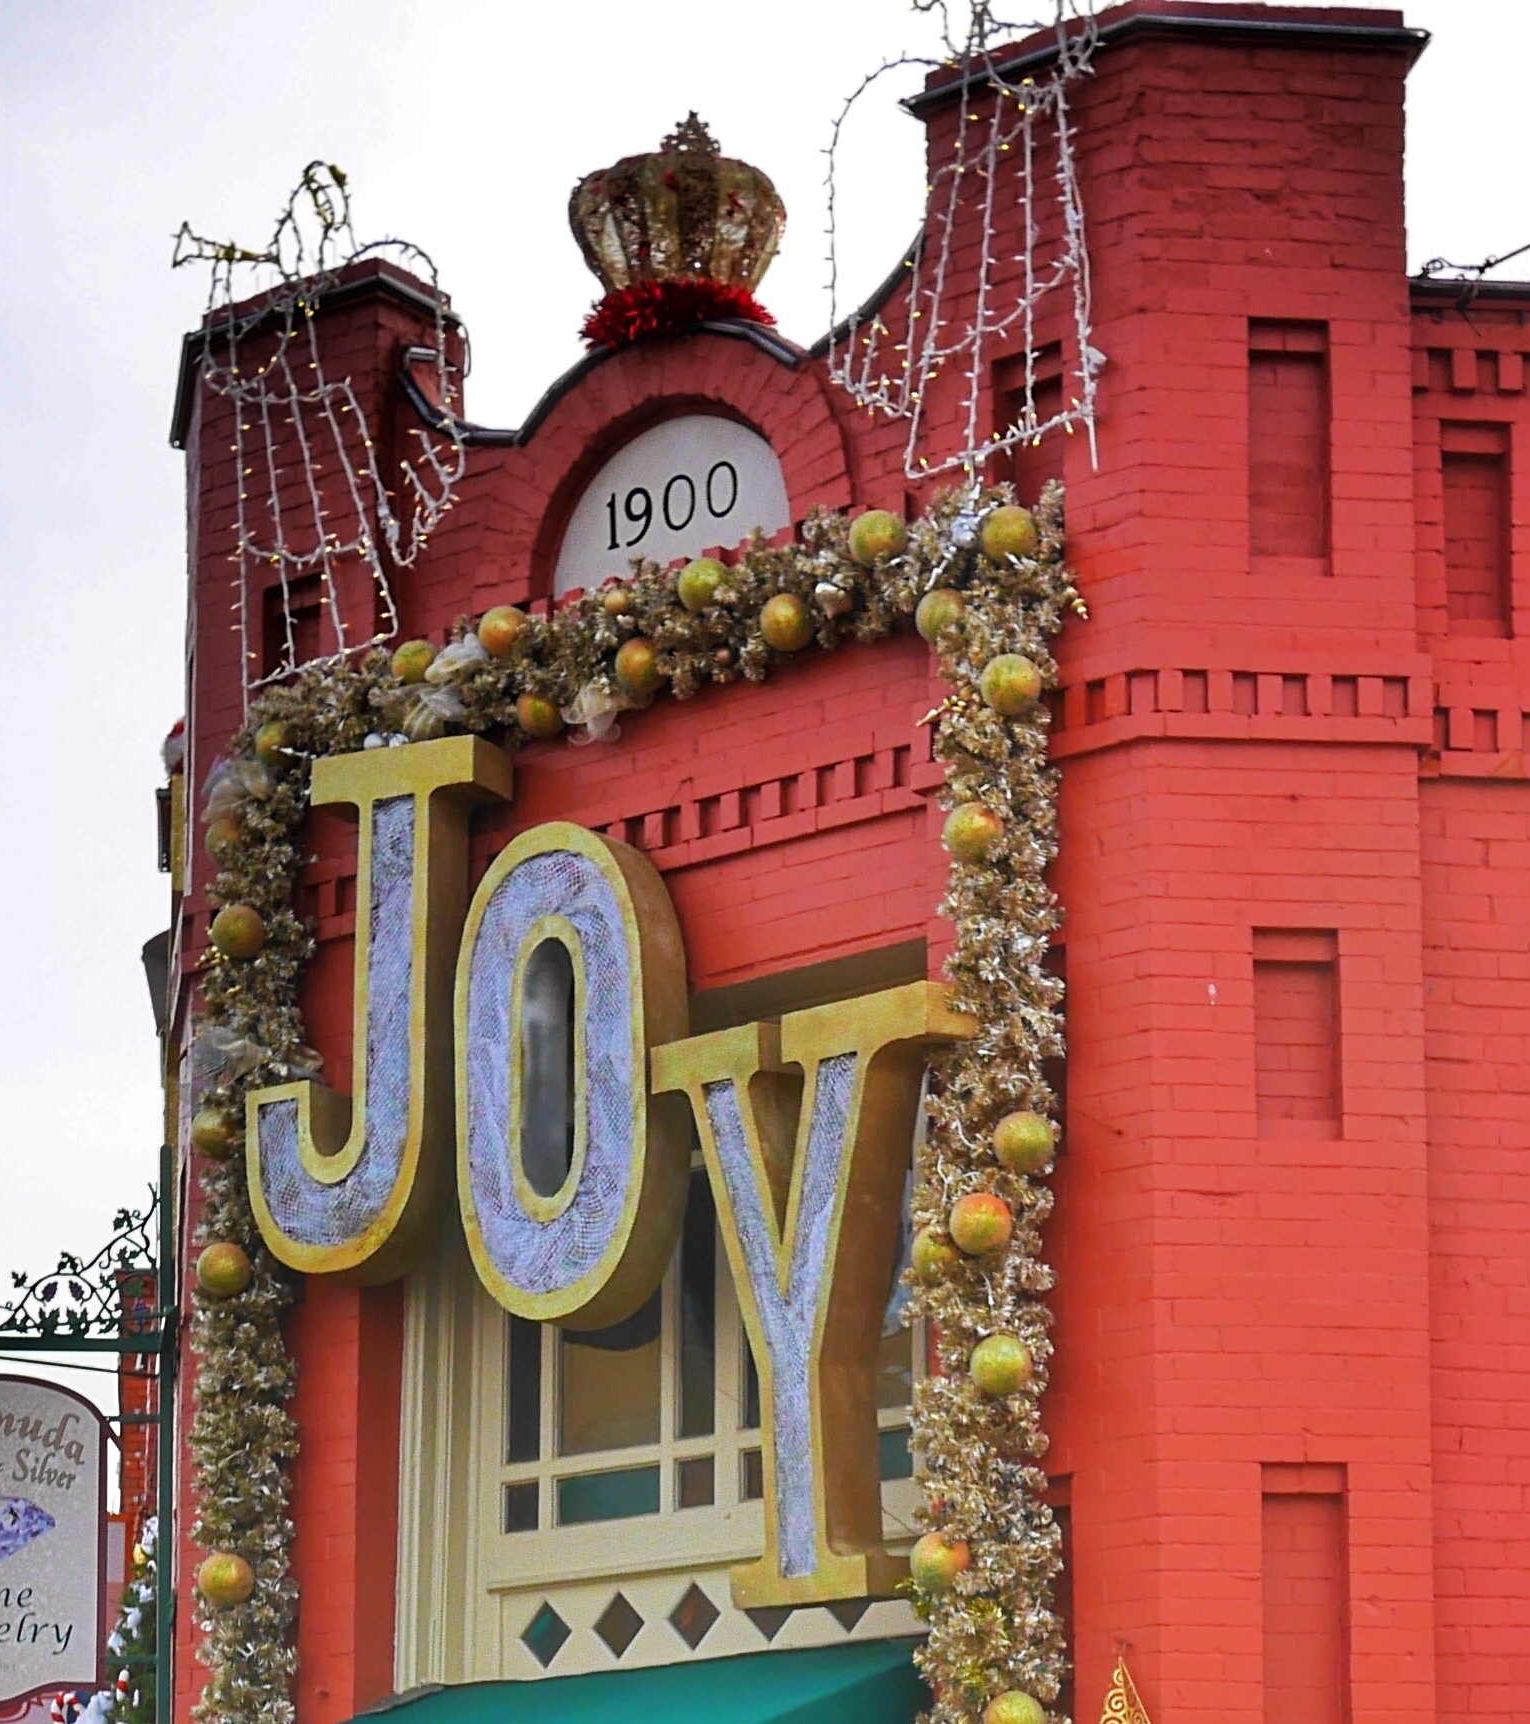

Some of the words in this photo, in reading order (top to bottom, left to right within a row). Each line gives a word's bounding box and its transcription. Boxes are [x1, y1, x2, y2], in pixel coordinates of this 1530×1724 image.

[606, 461, 738, 550] 1900
[245, 733, 982, 1611] JOY
[12, 1447, 77, 1490] Silver
